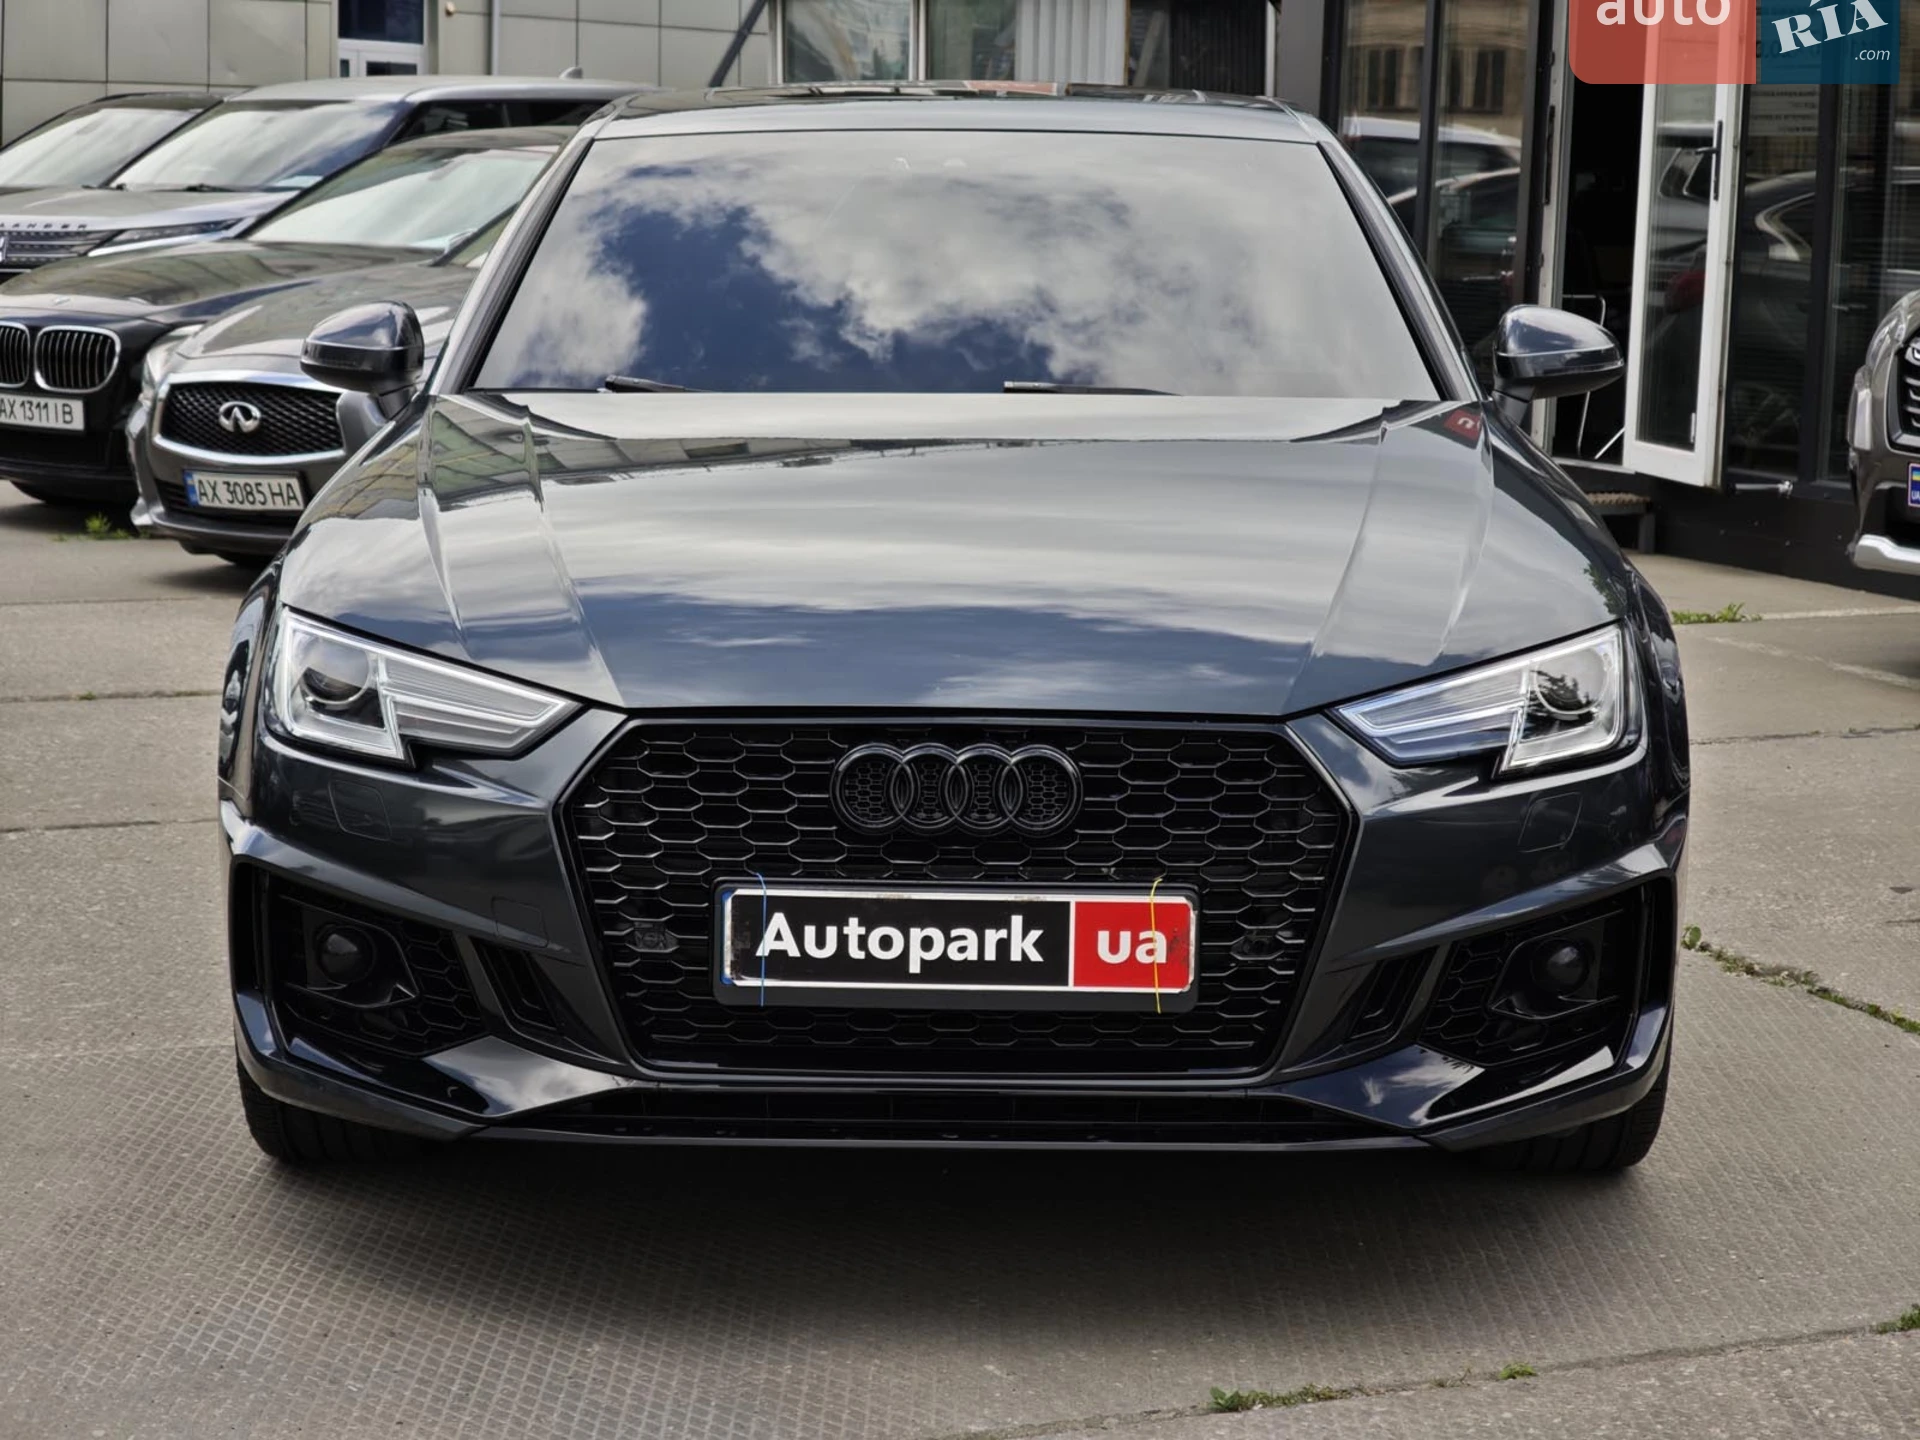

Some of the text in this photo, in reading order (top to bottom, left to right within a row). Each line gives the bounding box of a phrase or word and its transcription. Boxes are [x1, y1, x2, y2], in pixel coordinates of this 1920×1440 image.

[0, 397, 74, 424] AX 1311 IB
[198, 479, 300, 506] AX 3085 HA
[755, 912, 1168, 974] Autopark ua
